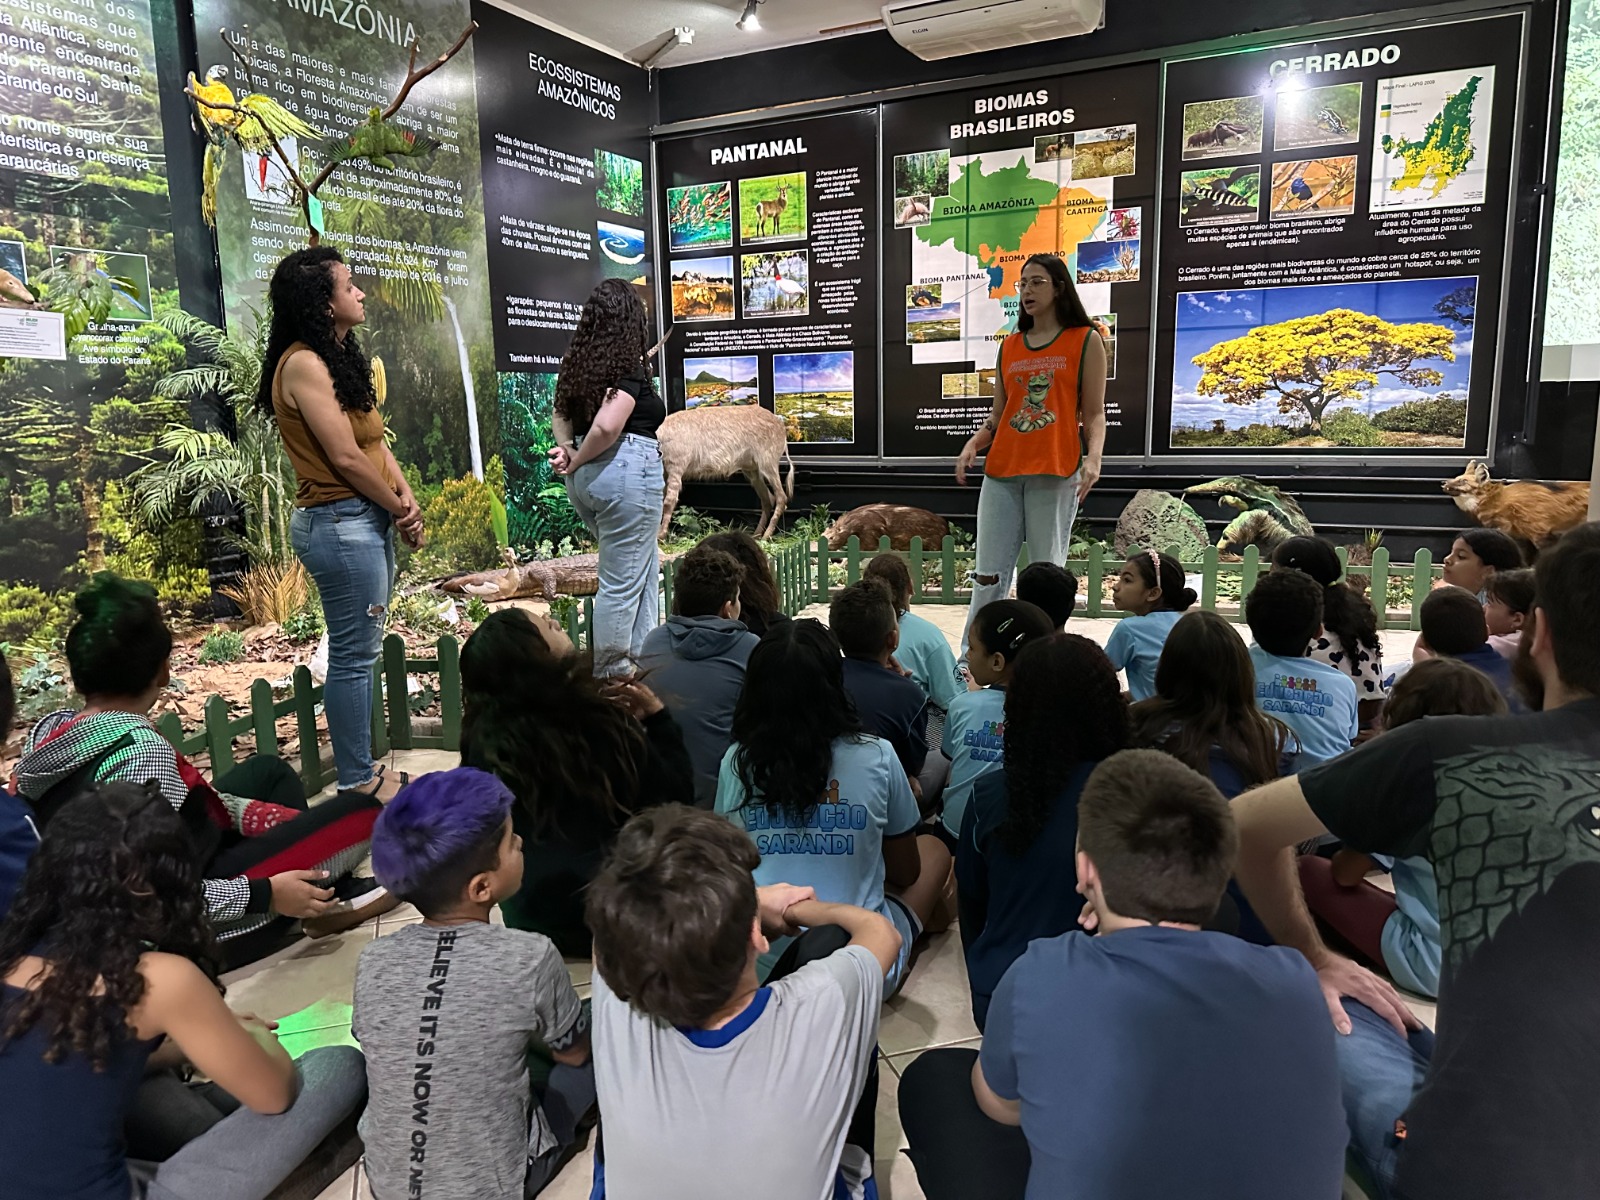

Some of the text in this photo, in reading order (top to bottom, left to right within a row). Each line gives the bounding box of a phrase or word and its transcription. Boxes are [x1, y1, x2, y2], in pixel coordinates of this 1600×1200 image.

[106, 0, 135, 20] dos
[21, 15, 138, 58] Atlântica, sendo
[108, 22, 137, 39] que
[55, 46, 141, 77] encontrada
[265, 43, 286, 58] das
[292, 52, 334, 73] maiores
[352, 71, 374, 86] mais
[1269, 44, 1401, 79] CERRADO
[29, 56, 91, 86] Paraná,
[100, 74, 143, 97] Santa
[529, 52, 621, 102] ECOSSISTEMAS
[54, 83, 73, 99] do
[75, 87, 103, 106] Sul.
[296, 68, 335, 90] Floresta
[339, 82, 391, 107] Amazônica,
[417, 105, 427, 116] de
[431, 110, 442, 120] ser
[446, 115, 457, 125] um
[537, 79, 616, 120] AMAZÔNICOS
[974, 89, 1049, 115] BIOMAS
[275, 80, 295, 94] rico
[301, 88, 316, 100] em
[396, 115, 422, 130] abriga
[437, 126, 458, 139] maior
[285, 100, 298, 112] de
[304, 103, 330, 120] água
[17, 116, 61, 136] nome
[66, 127, 119, 148] sugere,
[124, 137, 148, 152] sua
[950, 108, 1075, 140] BRASILEIROS
[63, 143, 73, 157] é
[76, 150, 85, 160] a
[87, 150, 150, 171] presença
[710, 137, 808, 166] PANTANAL
[0, 153, 79, 177] araucárias
[346, 172, 358, 183] de
[360, 175, 432, 199] aproximadamente
[453, 193, 463, 204] da
[419, 172, 455, 191] brasileiro,
[347, 187, 371, 201] Brasil
[380, 194, 391, 204] de
[392, 196, 405, 208] até
[406, 200, 424, 212] 20%
[425, 202, 435, 214] da
[454, 208, 464, 219] do
[943, 197, 1035, 216] BIOMA AMAZÔNIA
[1066, 198, 1094, 206] BIOMA
[1066, 205, 1109, 215] CAATINGA
[1193, 217, 1346, 236] Cerrado, segundo maior bioma brasileiro, abriga
[1369, 211, 1411, 224] Atualmente,
[250, 217, 282, 234] Assim
[355, 234, 371, 246] dos
[372, 236, 404, 251] biomas,
[413, 242, 450, 257] Amazônia
[451, 250, 467, 259] vem
[1209, 234, 1237, 242] espécies
[1302, 225, 1344, 235] encontrados
[1226, 241, 1250, 249] apenas
[1374, 228, 1408, 239] influência
[1398, 235, 1446, 243] agropecuário.
[252, 235, 284, 249] sendo
[447, 261, 468, 272] foram
[999, 254, 1026, 263] BIOMA
[255, 267, 268, 278] de
[354, 265, 469, 287] entre agosto de 2016 julho
[946, 273, 986, 282] PANTANAL
[78, 355, 108, 364] Estado
[83, 344, 98, 352] Ave
[1263, 700, 1325, 718] SARANDI
[756, 833, 854, 855] SARANDI
[416, 1015, 439, 1057] IT'S
[411, 1062, 433, 1125] NOW
[410, 1130, 427, 1163] OR
